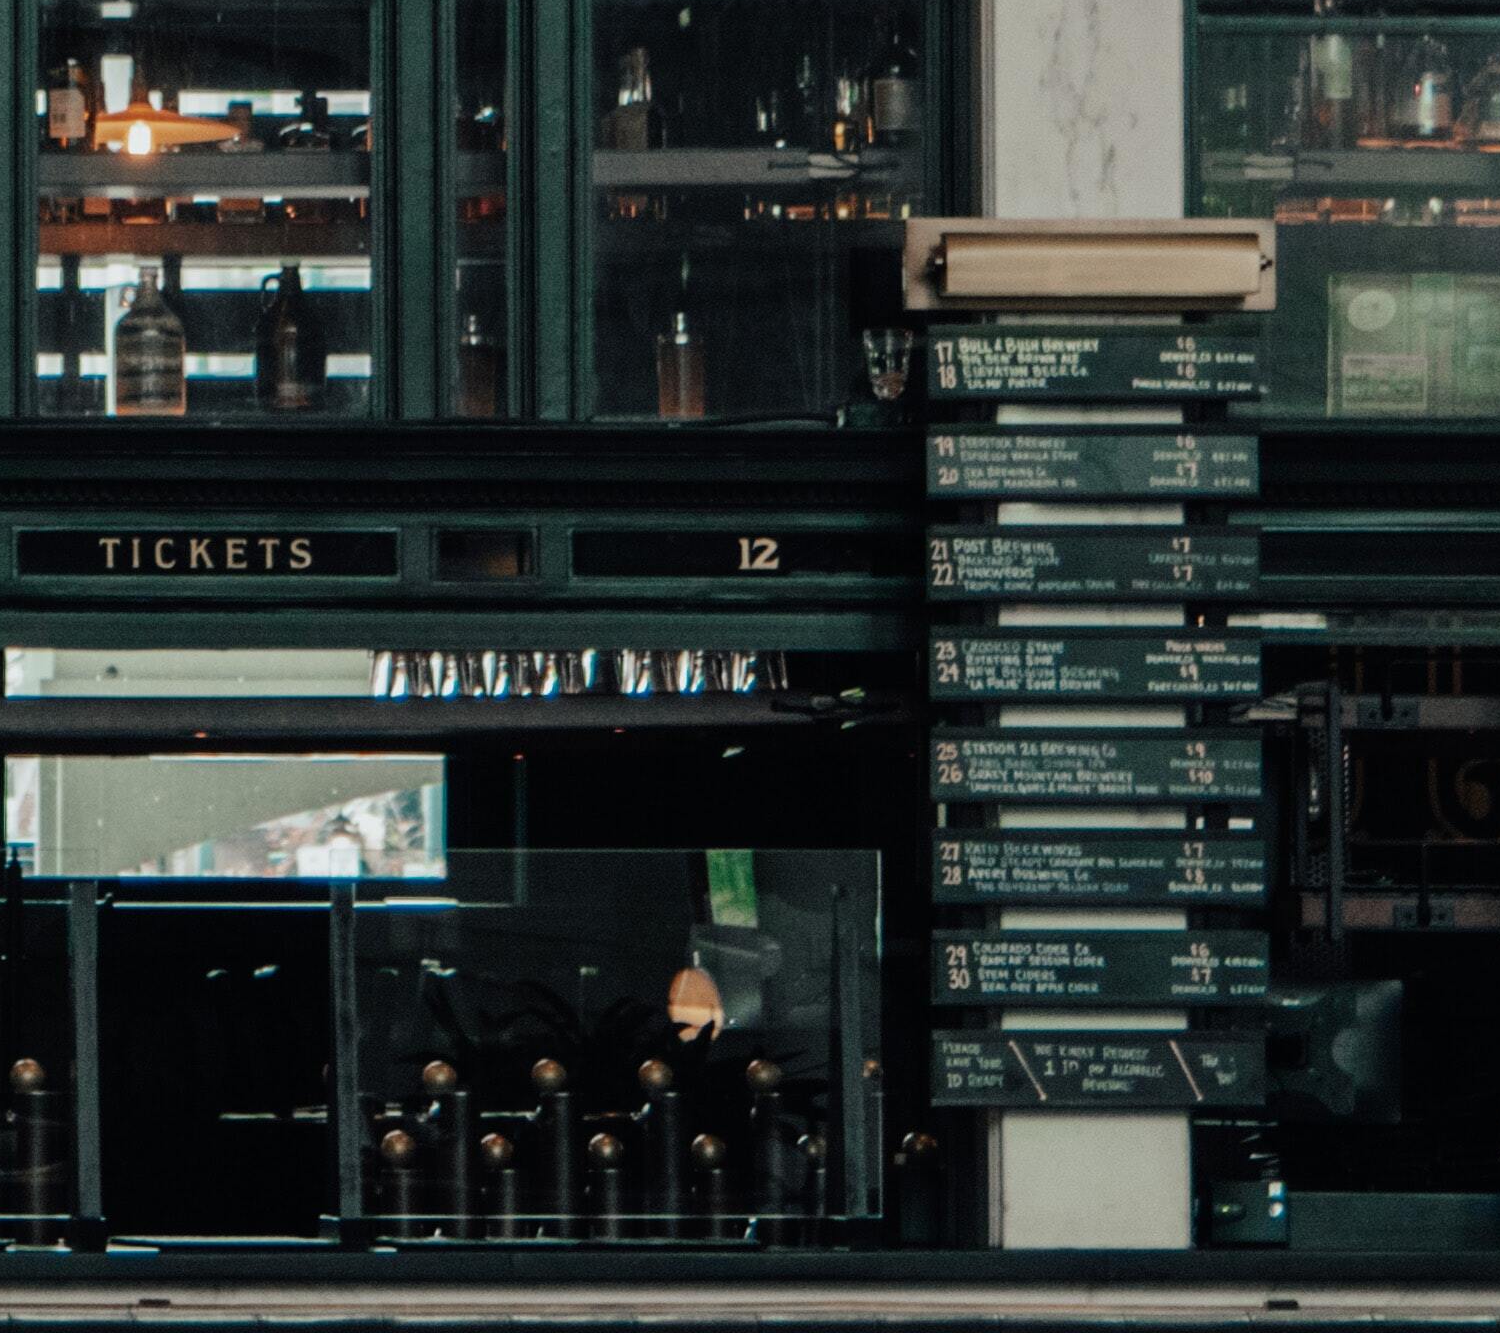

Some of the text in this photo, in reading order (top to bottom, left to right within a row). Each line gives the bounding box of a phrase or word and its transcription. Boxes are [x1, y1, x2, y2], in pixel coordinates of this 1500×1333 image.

[935, 337, 1098, 364] 17 BULL BUSH BREWERY
[937, 364, 956, 389] 18
[935, 435, 954, 457] 19
[938, 467, 959, 485] 20
[99, 537, 313, 570] TICKETS
[738, 537, 780, 570] 12
[931, 538, 1055, 561] 21 POST BREWING
[931, 563, 955, 586] 22
[935, 641, 957, 661] 23
[1026, 640, 1064, 654] STAVE
[937, 663, 959, 683] 24
[936, 743, 958, 761] 25
[961, 740, 1016, 756] STATION
[938, 764, 963, 784] 26
[1012, 770, 1072, 783] MOUNTAIN
[939, 842, 960, 862] 27
[941, 865, 962, 885] 28
[945, 944, 967, 966] 29
[972, 940, 1032, 955] COLORADO
[948, 968, 970, 989] 30
